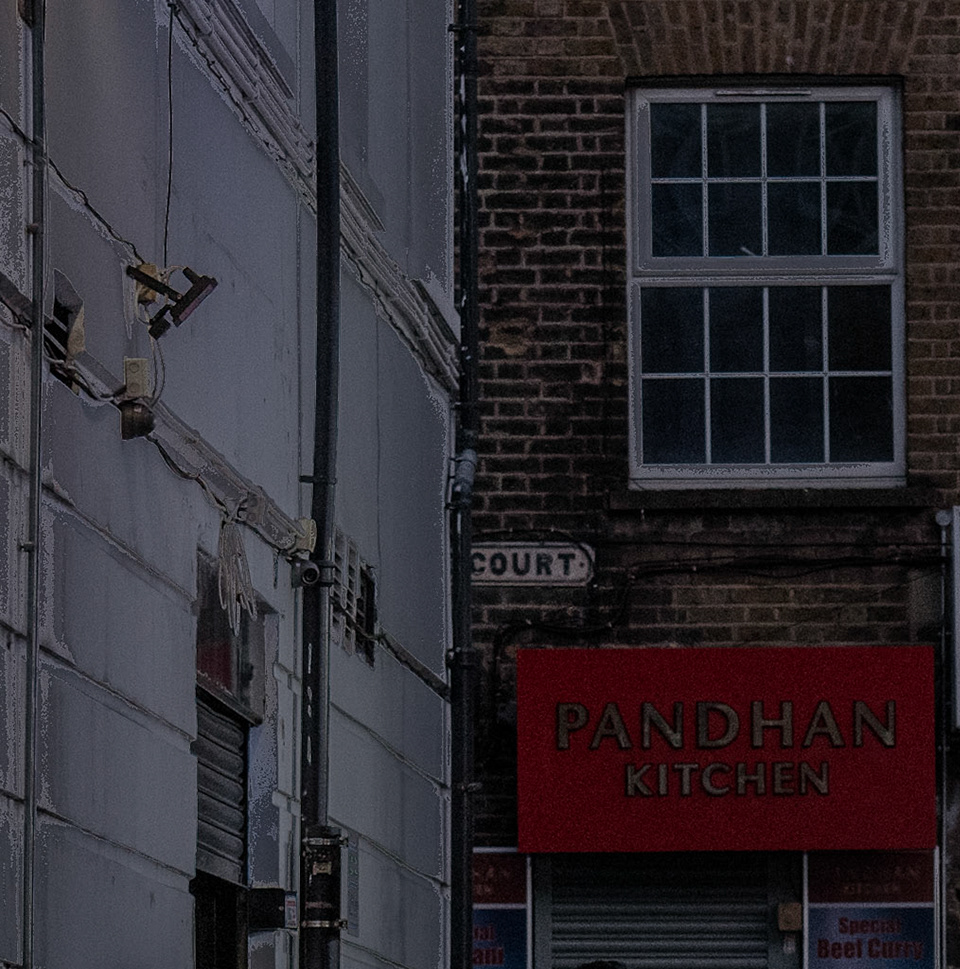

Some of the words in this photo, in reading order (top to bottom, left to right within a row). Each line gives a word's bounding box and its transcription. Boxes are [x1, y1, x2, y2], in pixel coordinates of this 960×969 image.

[471, 552, 575, 575] COURT
[556, 699, 896, 750] PANDHAN
[624, 761, 830, 797] KITCHEN
[838, 917, 901, 935] Special
[868, 938, 923, 960] Curry
